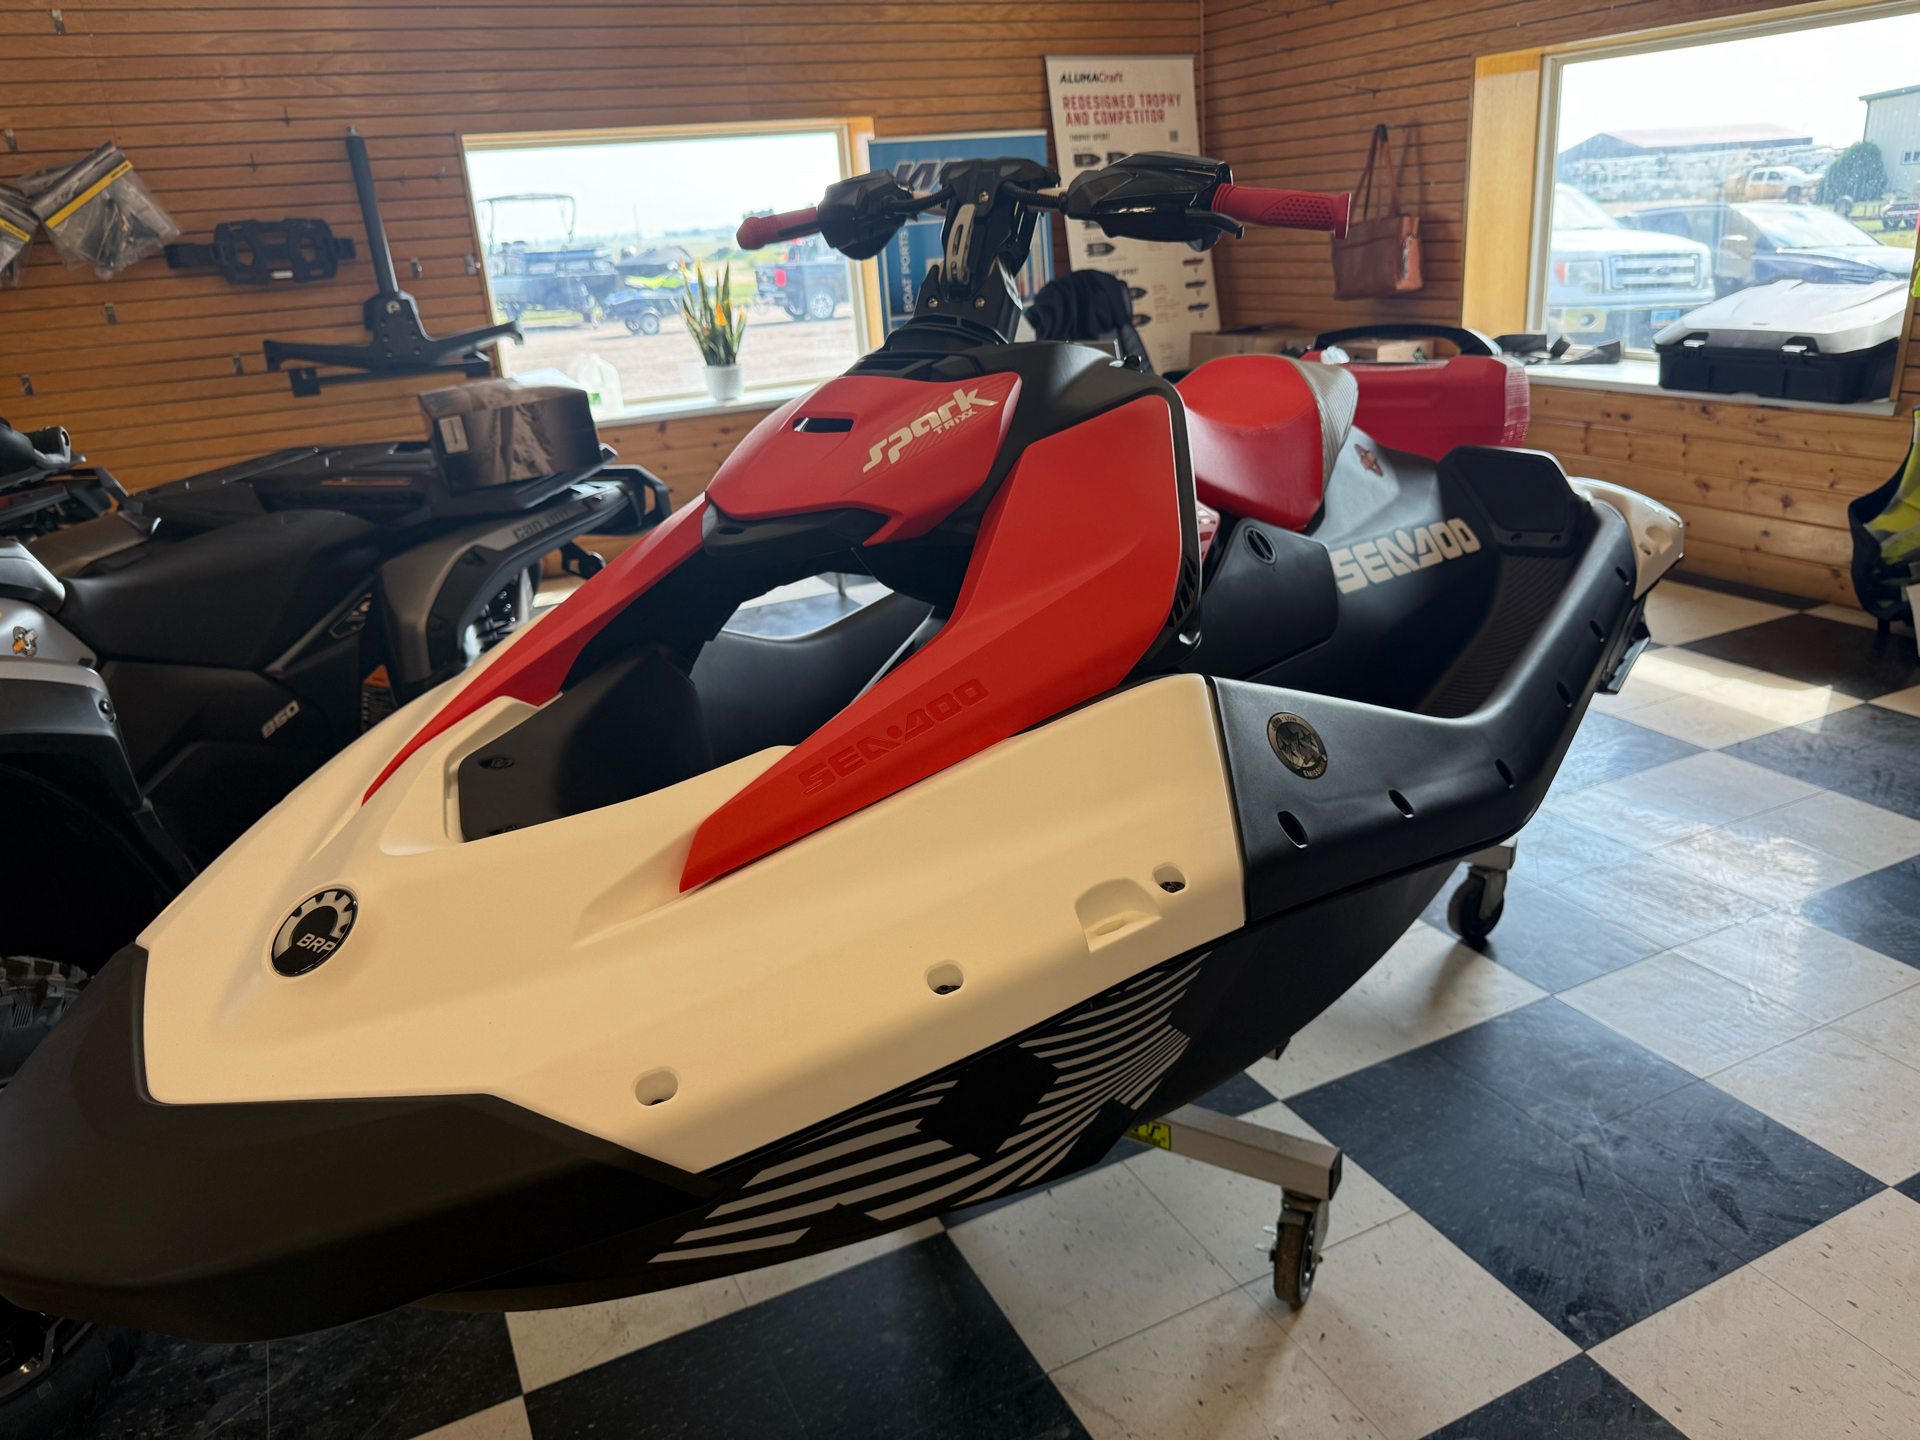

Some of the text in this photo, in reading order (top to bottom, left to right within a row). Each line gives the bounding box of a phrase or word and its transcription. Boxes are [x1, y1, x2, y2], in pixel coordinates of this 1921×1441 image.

[1062, 92, 1182, 111] REDESIGNED TROPHY
[1065, 109, 1166, 127] AND COMPETITOR
[898, 229, 914, 313] BOAT PORTS
[933, 408, 978, 435] TRIXX
[261, 700, 300, 739] 850
[296, 932, 337, 954] BRP
